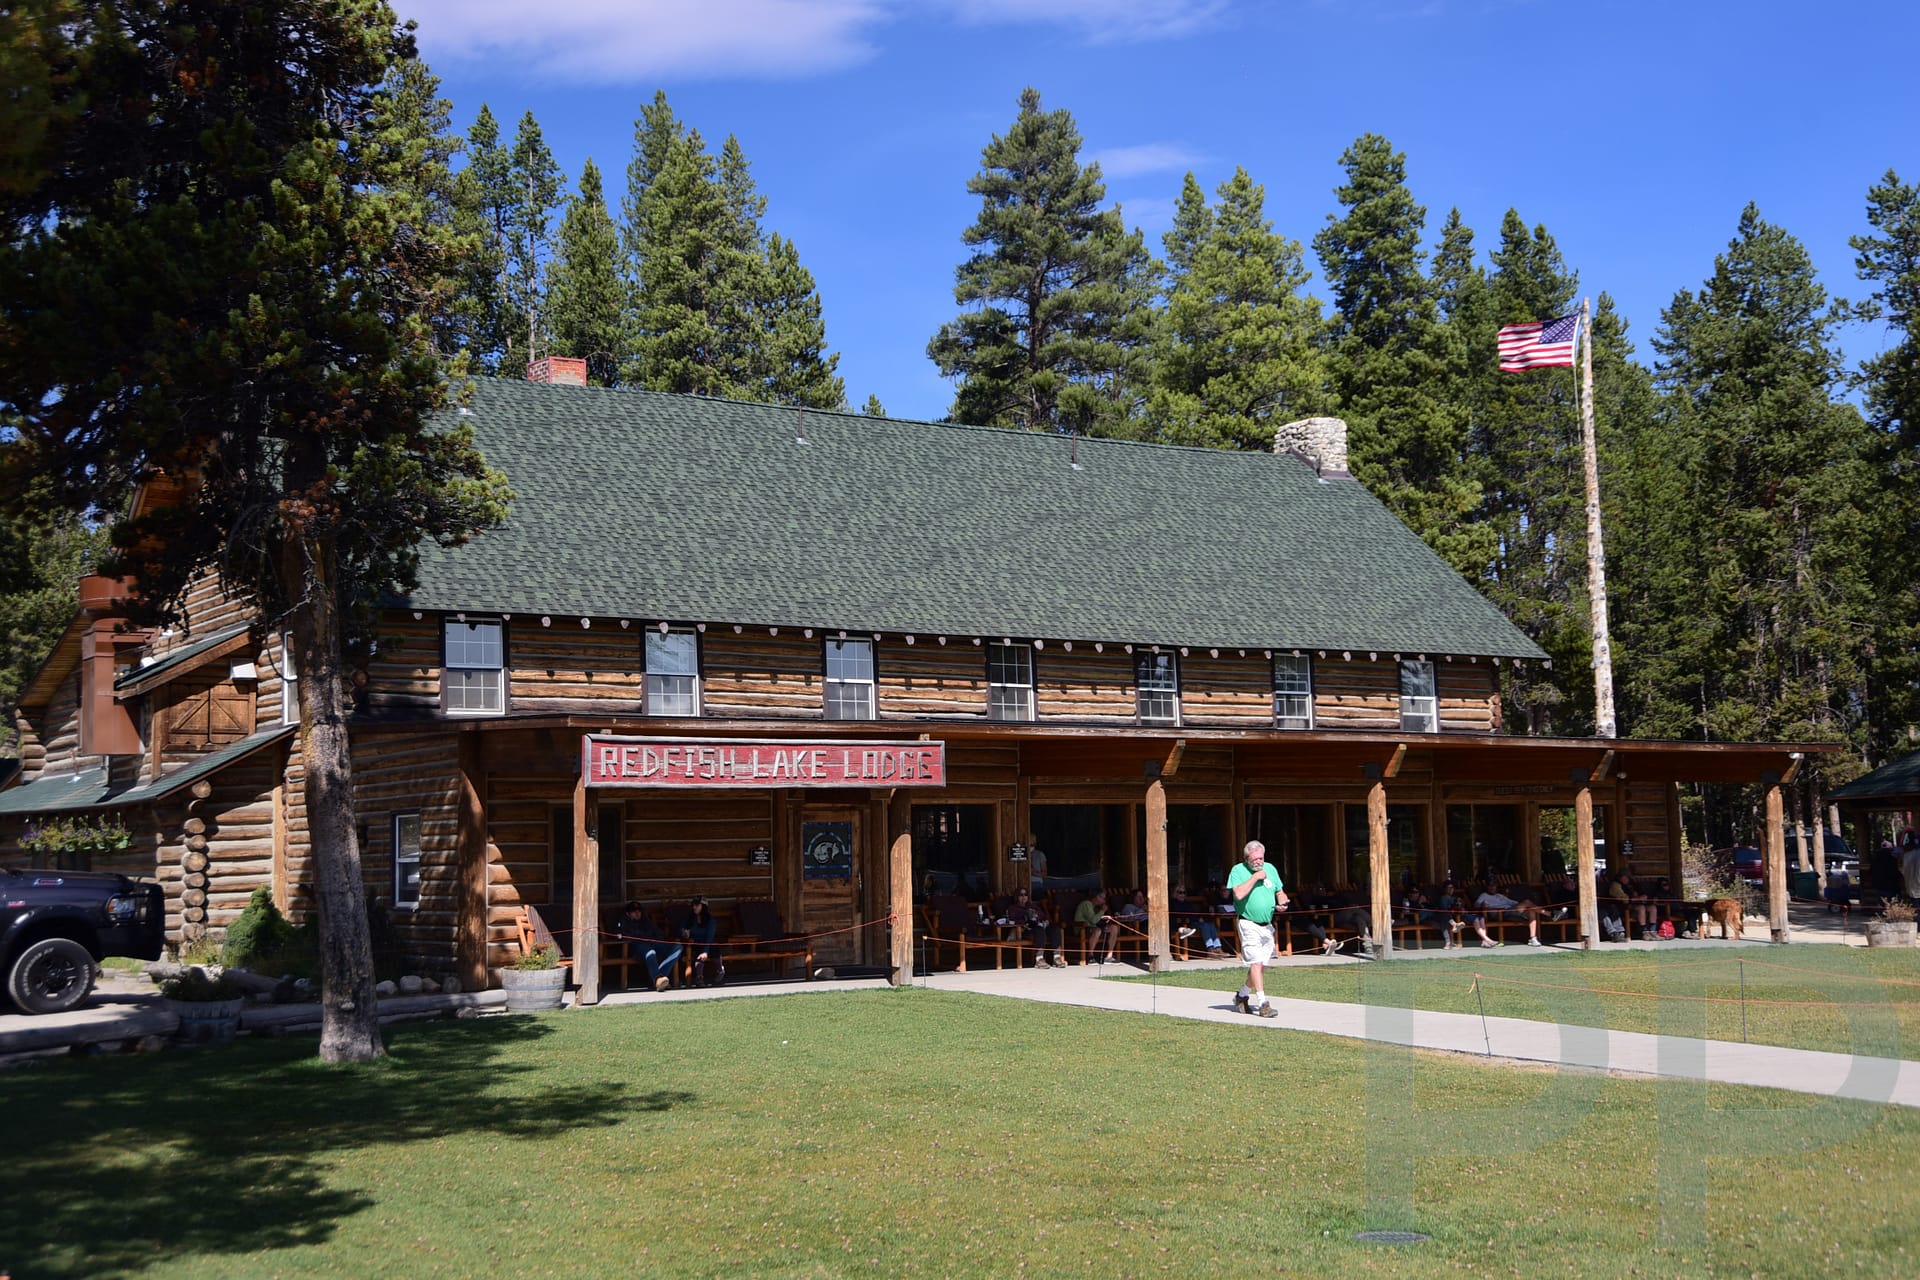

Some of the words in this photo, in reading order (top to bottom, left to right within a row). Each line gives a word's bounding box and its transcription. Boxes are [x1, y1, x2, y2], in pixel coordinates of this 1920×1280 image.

[600, 747, 736, 779] REDFISH
[753, 749, 828, 778] LAKE
[844, 750, 933, 779] LODGE
